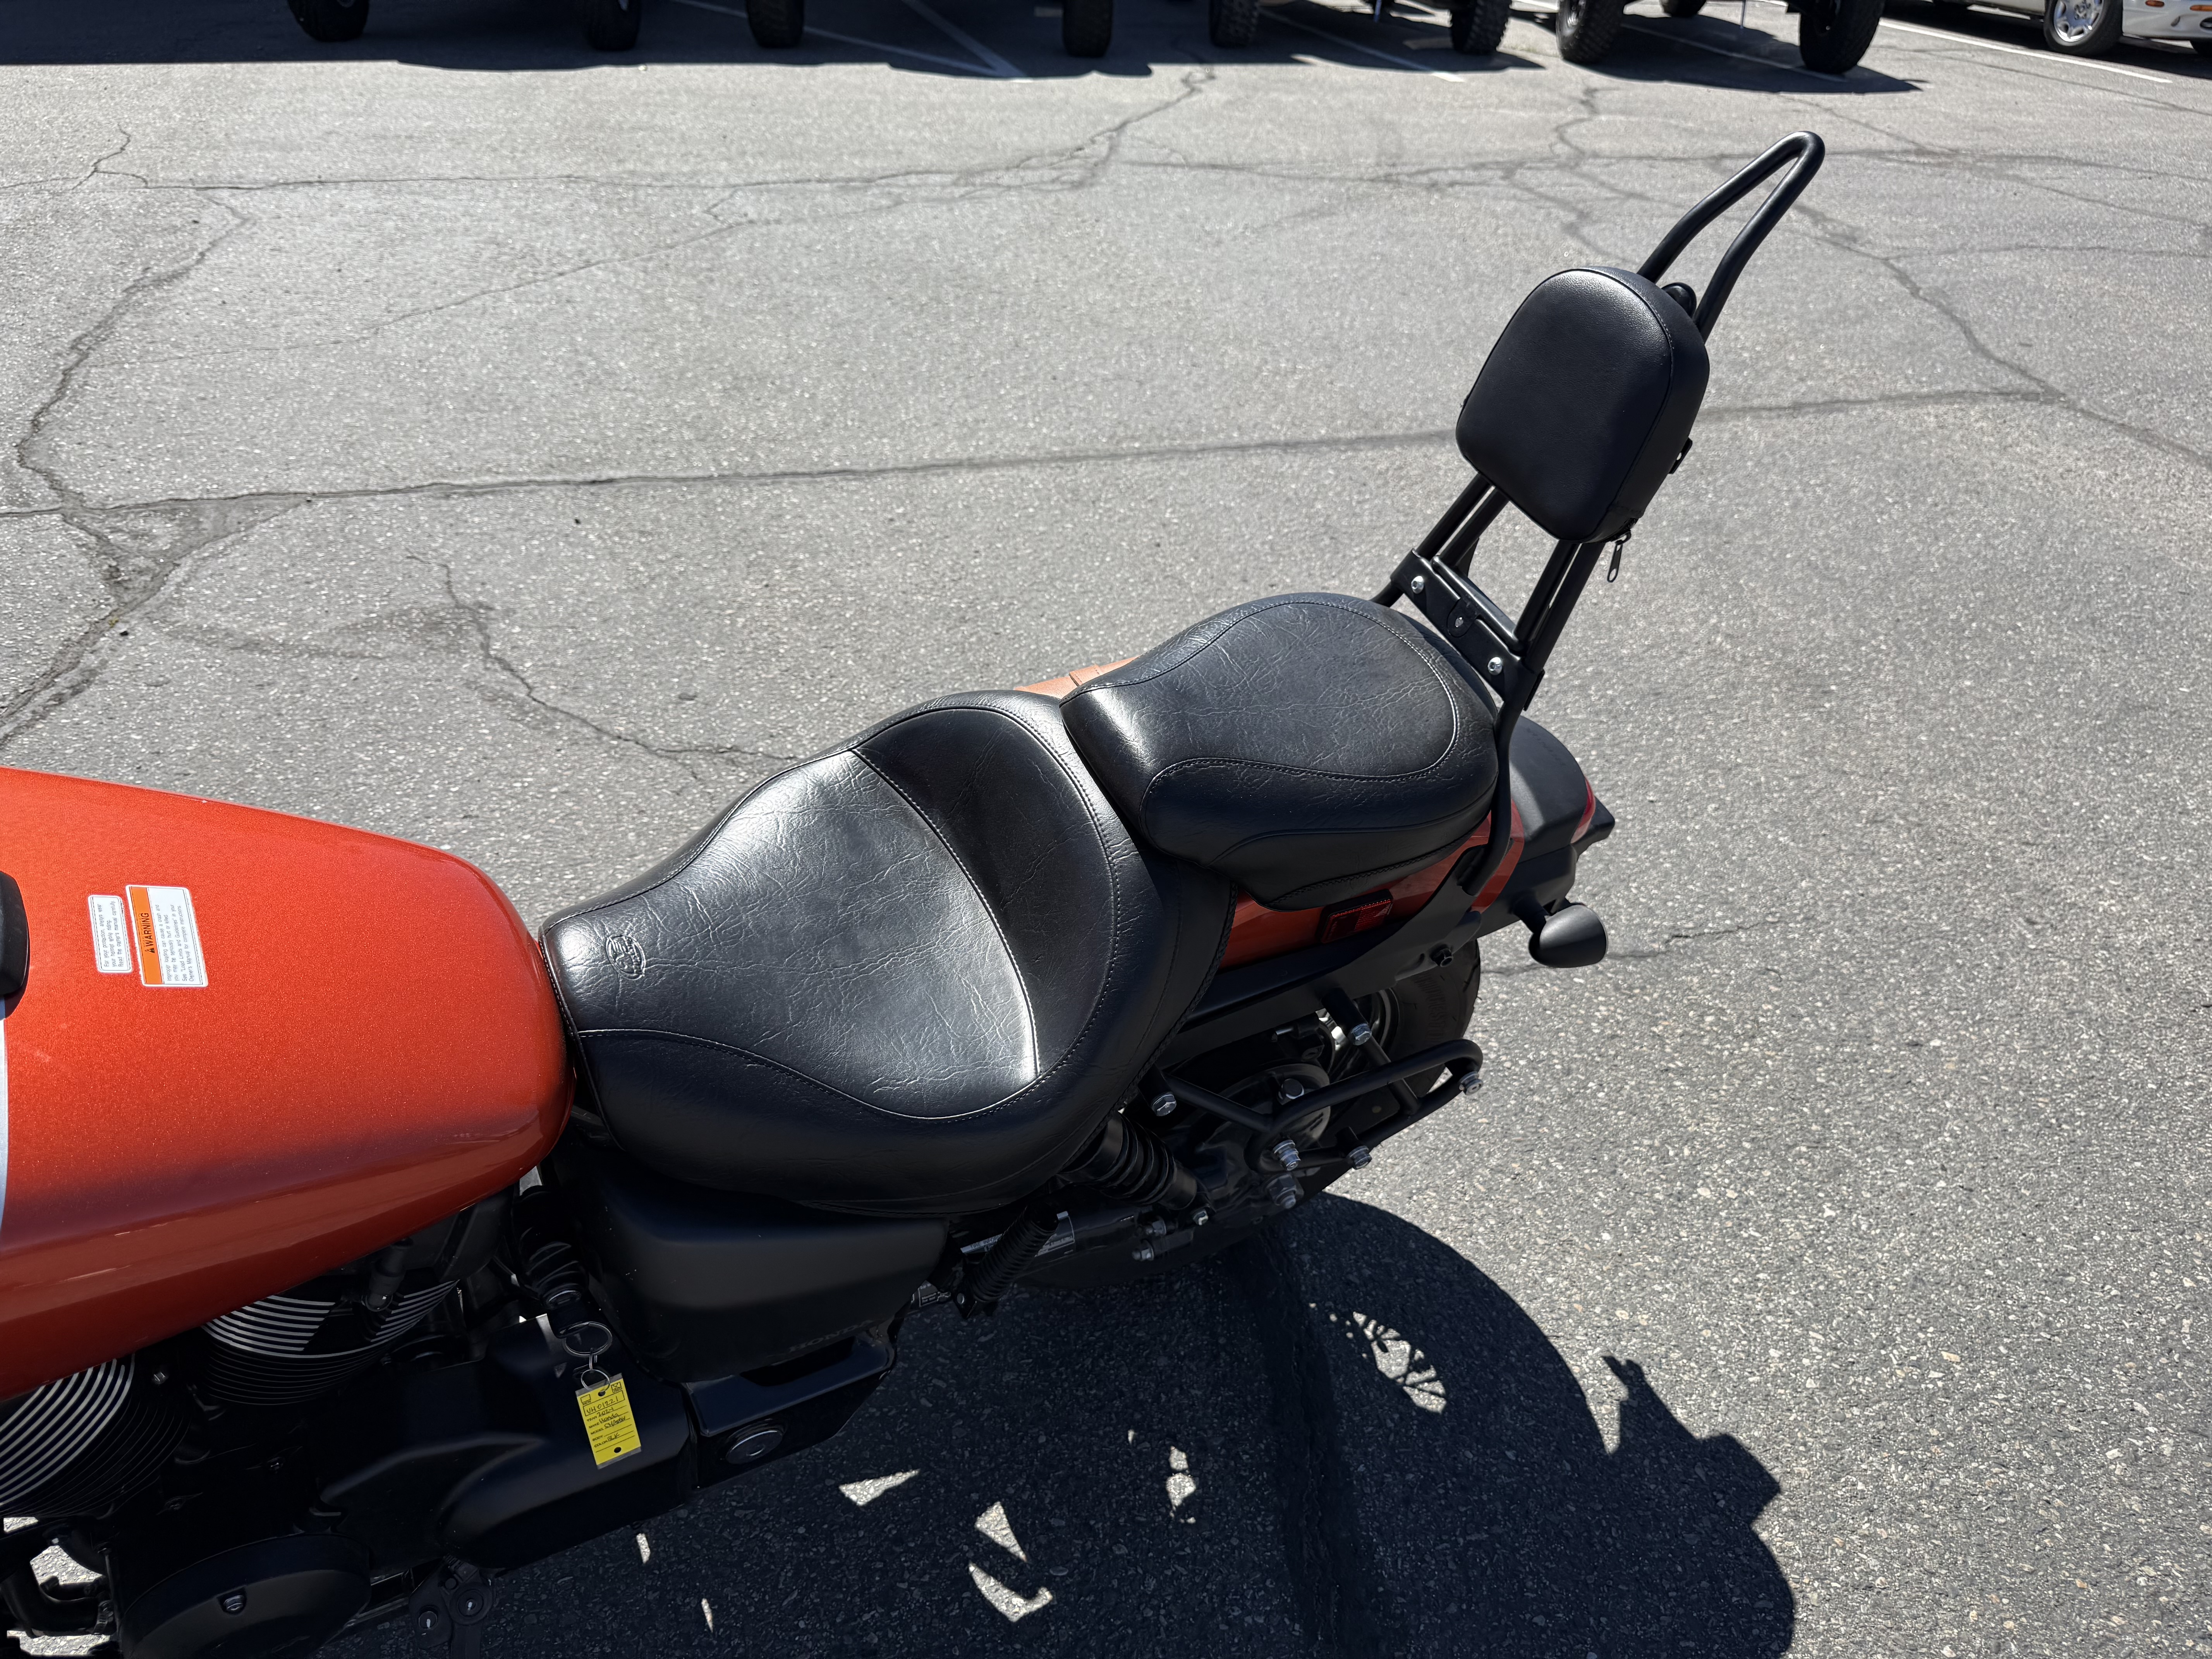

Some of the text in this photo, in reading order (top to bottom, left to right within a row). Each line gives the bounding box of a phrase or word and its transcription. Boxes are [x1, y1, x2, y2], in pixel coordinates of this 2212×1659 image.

[141, 913, 154, 946] WARNING
[788, 1319, 874, 1353] HONDA
[596, 1407, 614, 1417] 2024
[607, 1432, 620, 1442] BLK
